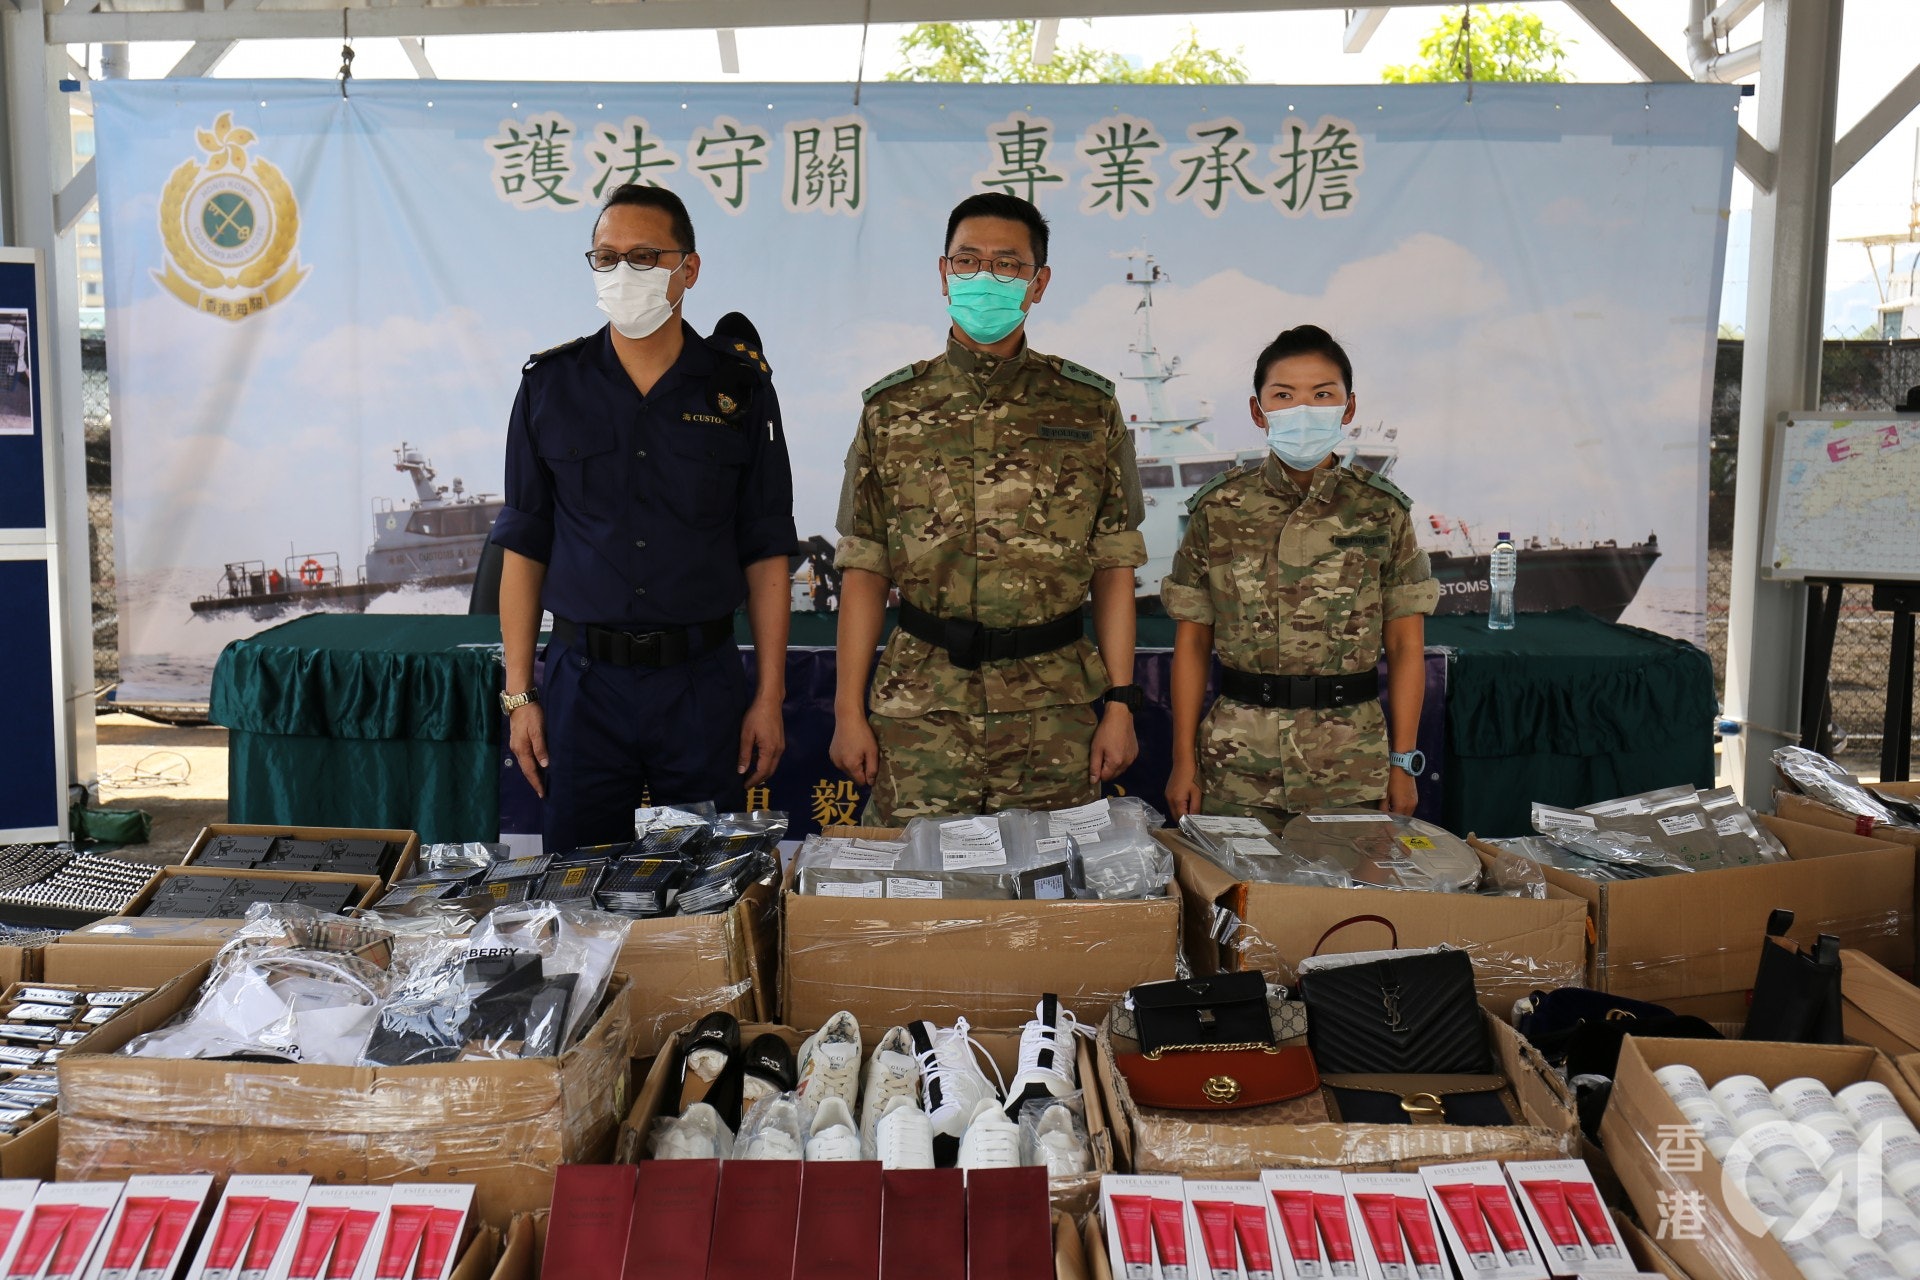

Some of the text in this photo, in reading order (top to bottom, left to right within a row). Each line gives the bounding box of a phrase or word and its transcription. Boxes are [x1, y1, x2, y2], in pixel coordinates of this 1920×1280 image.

[494, 119, 1359, 212] 護法守關 專業承擔
[200, 180, 254, 198] HONG KONG
[205, 297, 263, 317] 香港海關
[693, 414, 722, 424] CUSTO
[1440, 580, 1489, 596] STOMS
[811, 778, 859, 827] 毅
[232, 847, 264, 855] Kingston
[345, 852, 377, 860] Kingston
